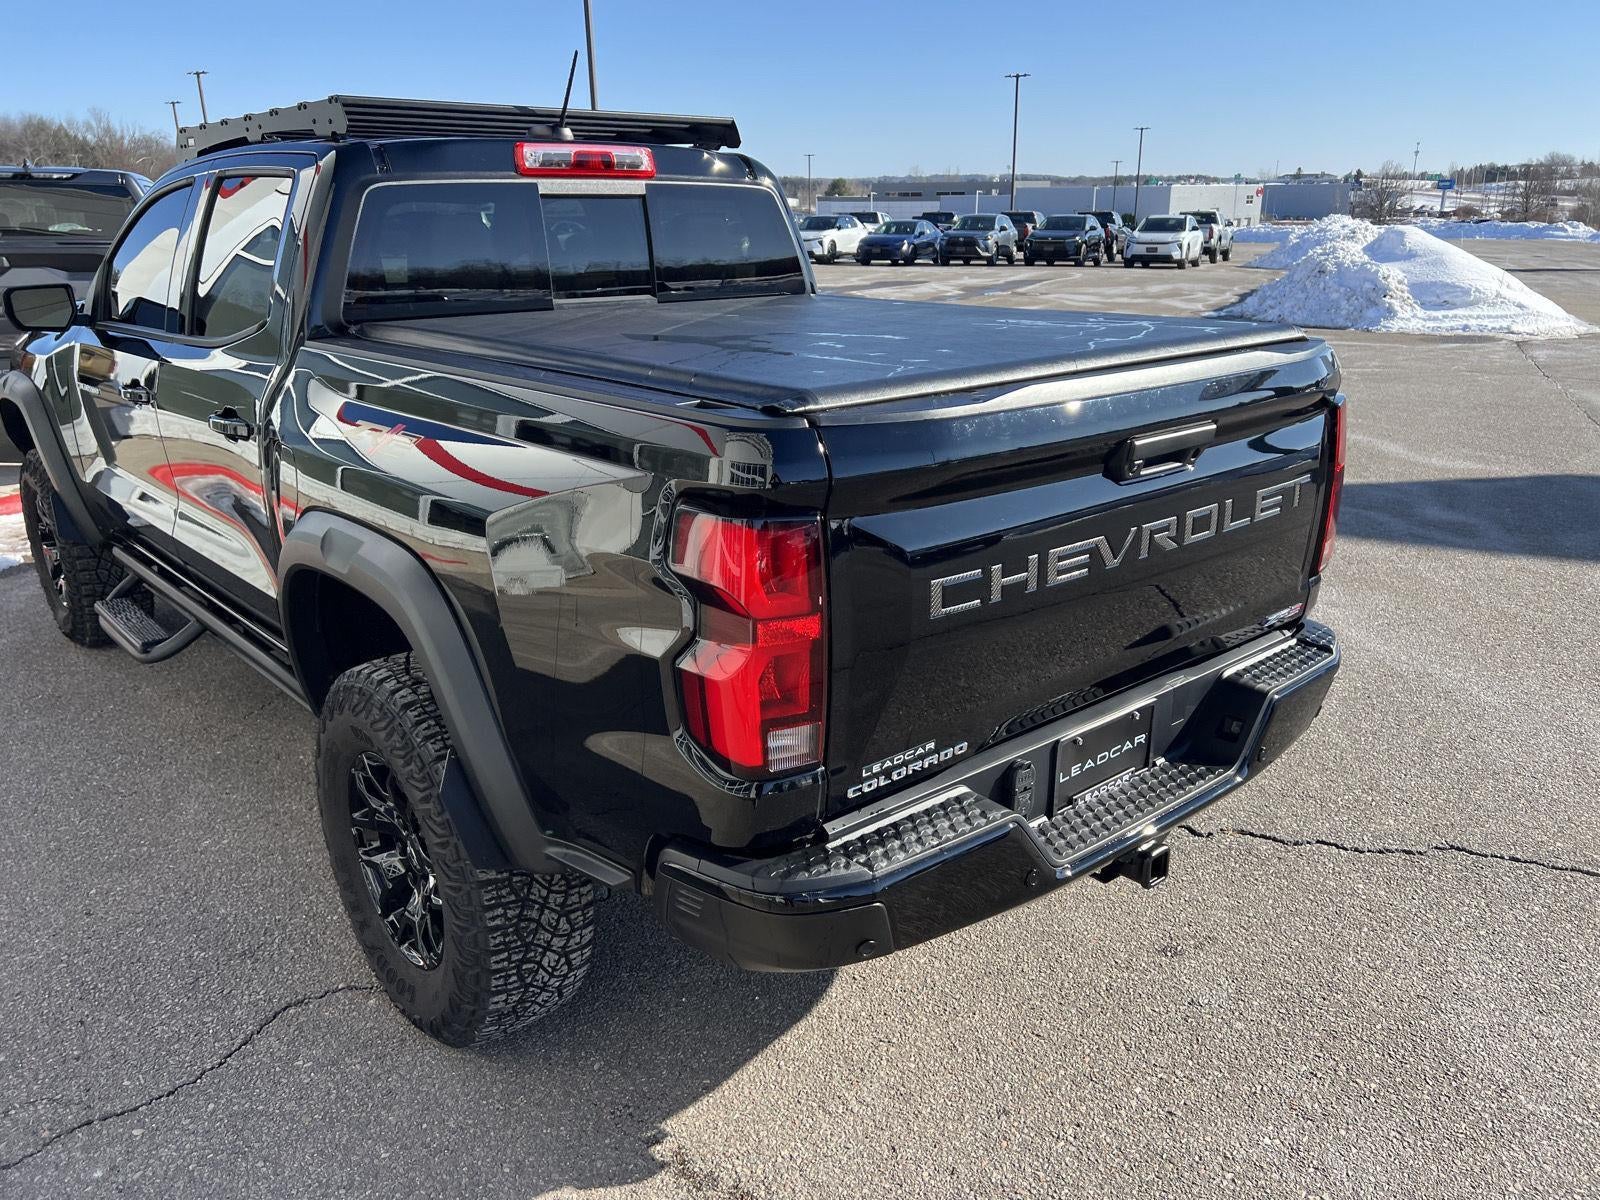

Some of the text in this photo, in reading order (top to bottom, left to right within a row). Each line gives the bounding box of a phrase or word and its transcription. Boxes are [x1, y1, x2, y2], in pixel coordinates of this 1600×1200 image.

[929, 474, 1312, 619] CHEVROLET
[846, 741, 968, 799] COLORADO
[862, 741, 936, 777] LEADCAR
[1059, 733, 1146, 783] LEADCAR
[1077, 774, 1129, 805] LEADCAR
